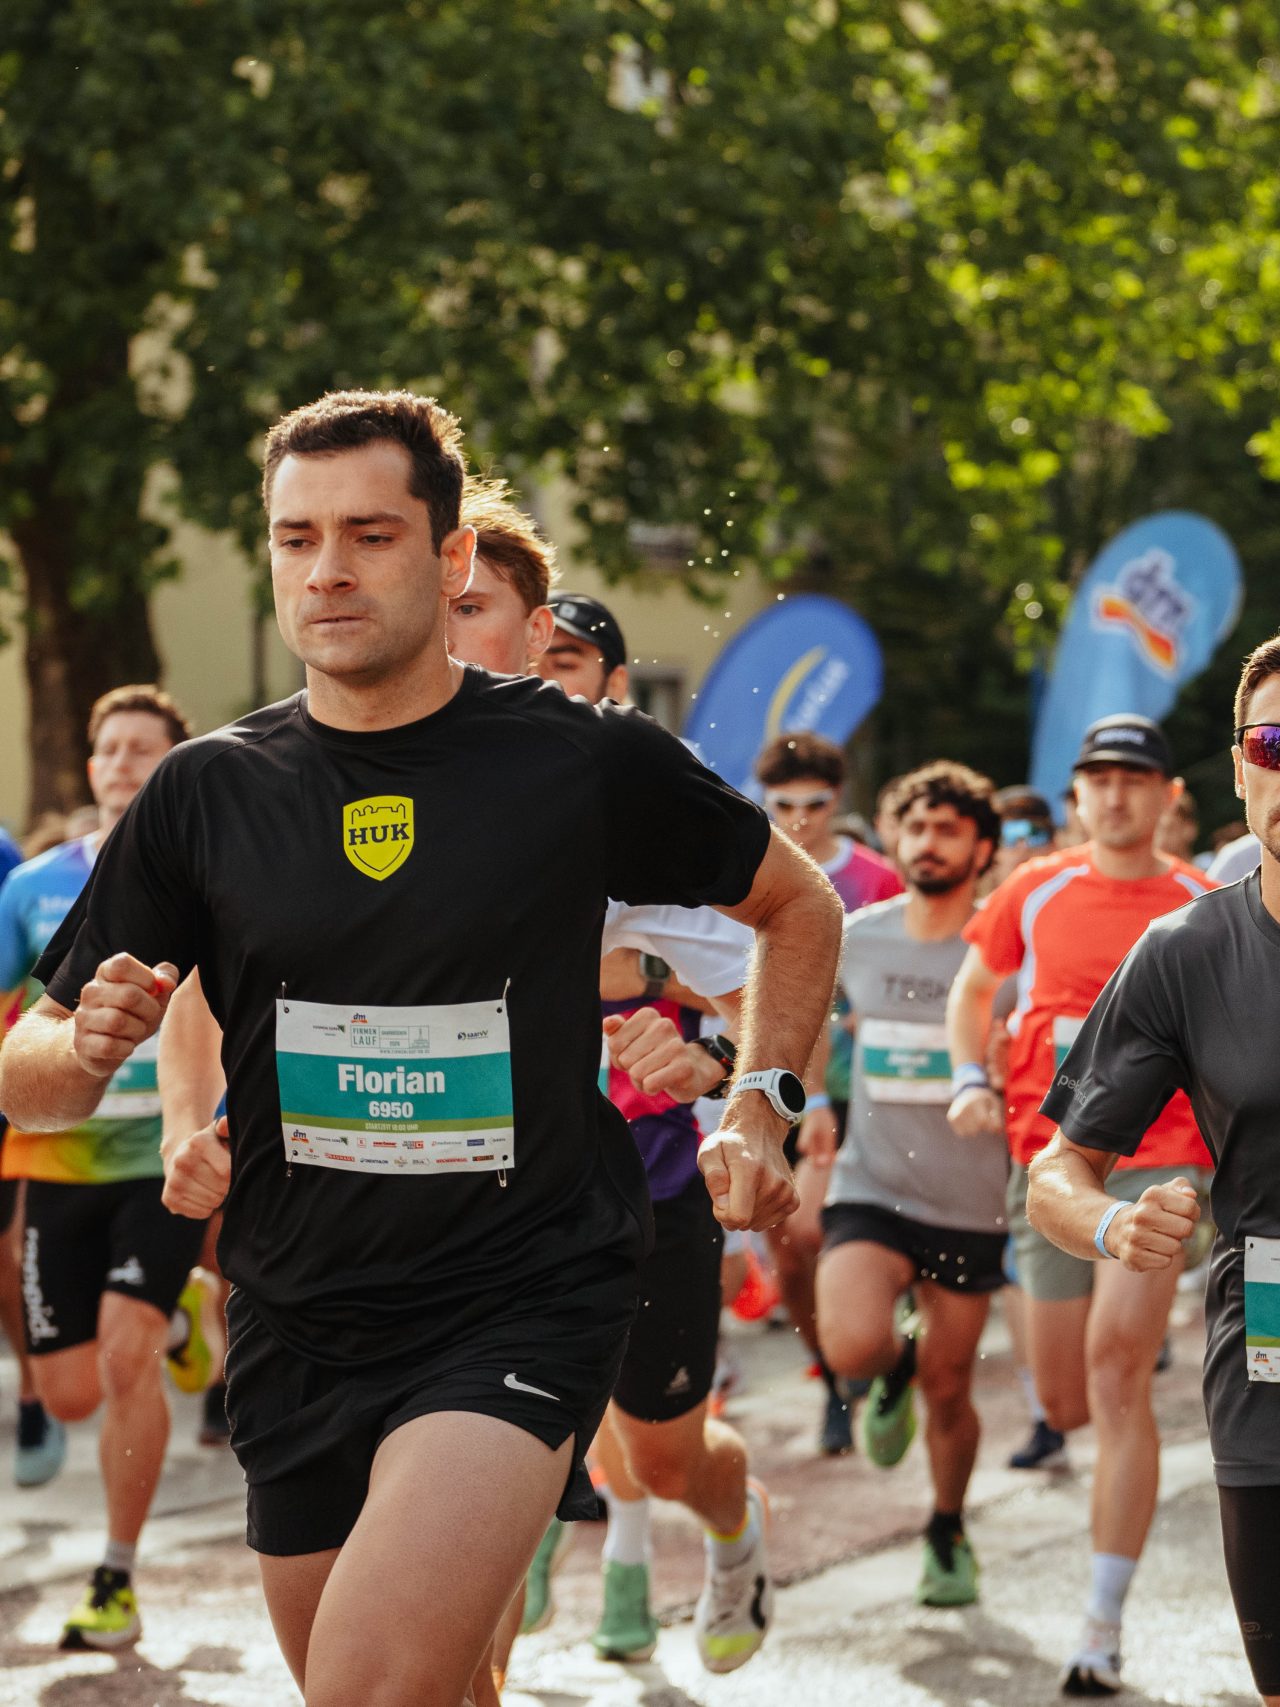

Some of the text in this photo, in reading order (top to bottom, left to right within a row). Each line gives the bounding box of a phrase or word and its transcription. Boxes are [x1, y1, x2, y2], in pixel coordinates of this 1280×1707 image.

[348, 822, 410, 846] HUK
[353, 1035, 377, 1046] LAUF
[338, 1063, 446, 1095] Florian
[368, 1101, 414, 1119] 6950
[293, 1129, 307, 1138] dm
[1255, 1351, 1267, 1359] dm
